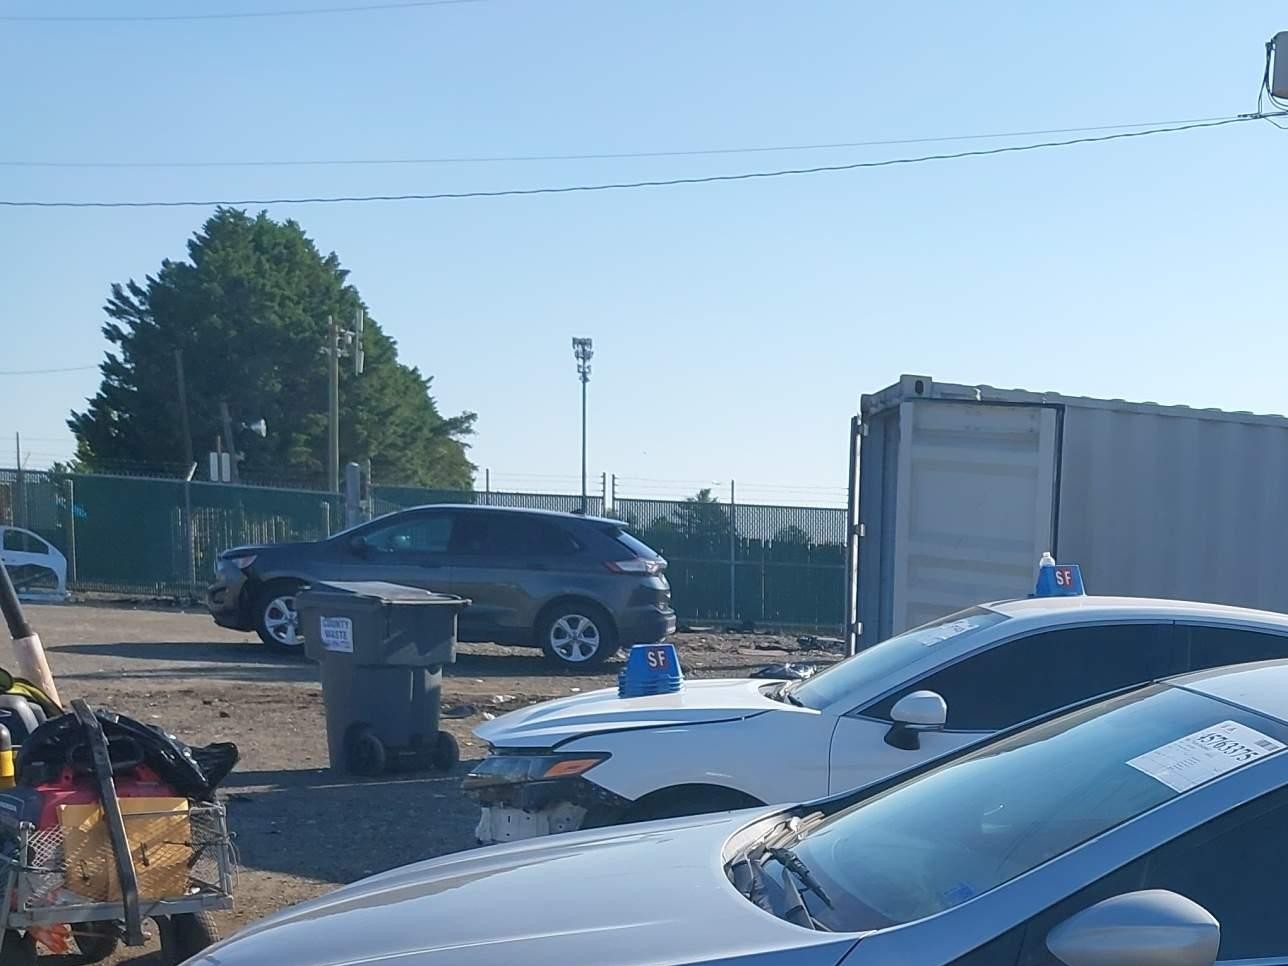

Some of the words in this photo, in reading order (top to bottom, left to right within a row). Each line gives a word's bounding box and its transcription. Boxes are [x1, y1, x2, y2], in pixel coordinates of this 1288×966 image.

[1055, 570, 1072, 585] SF
[324, 629, 348, 641] WASTE
[647, 650, 666, 667] SF
[1197, 732, 1260, 762] 45763375
